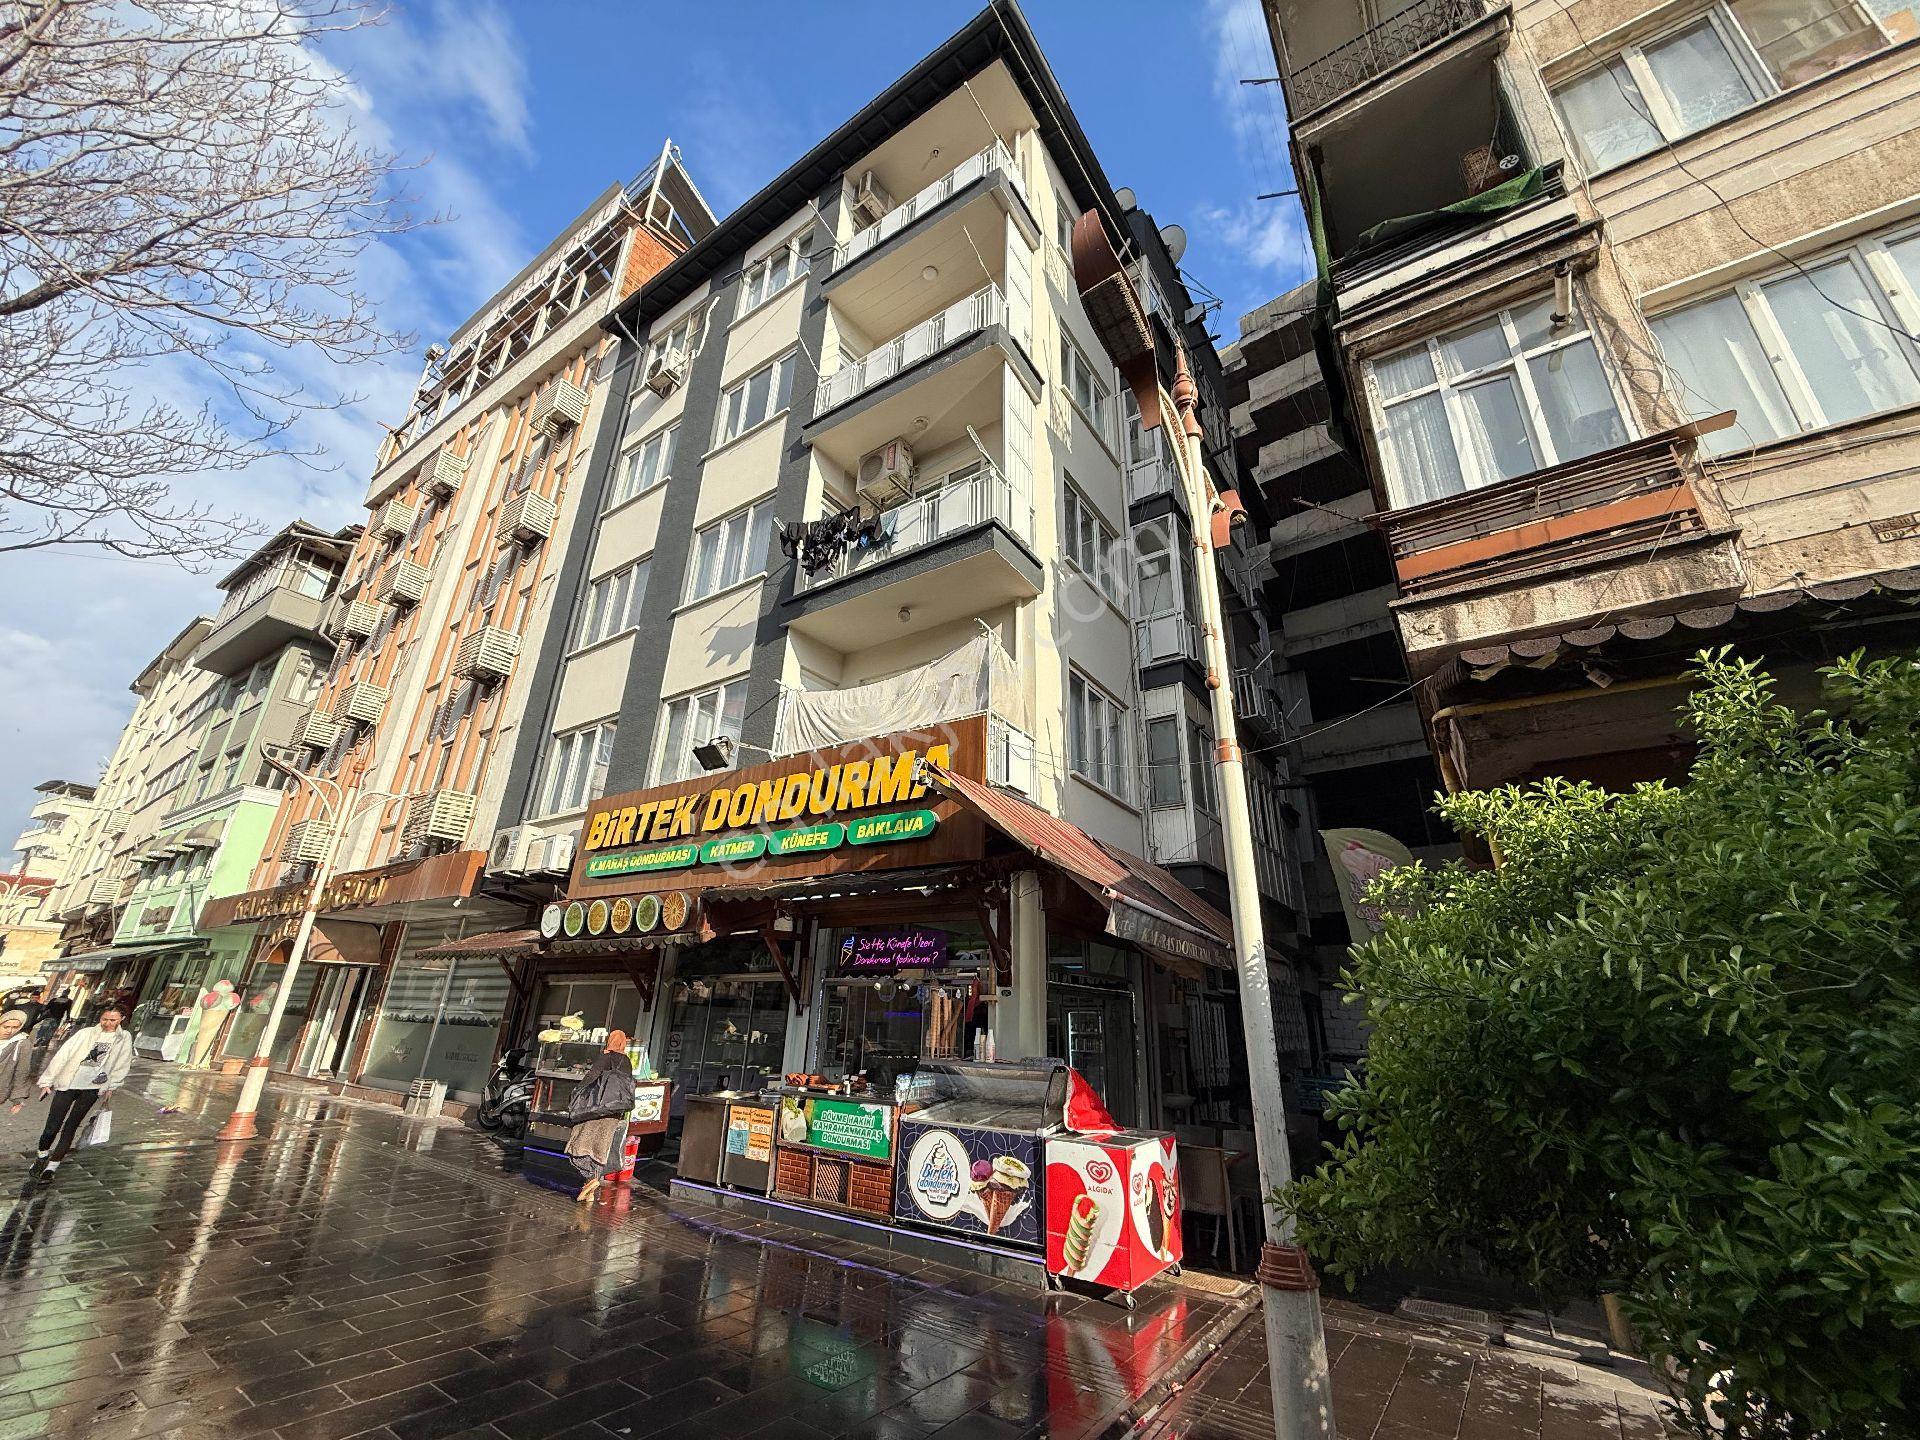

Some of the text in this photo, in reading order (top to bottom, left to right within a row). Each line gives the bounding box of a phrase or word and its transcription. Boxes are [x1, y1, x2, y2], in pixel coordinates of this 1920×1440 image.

[701, 743, 950, 832] DONDURMA
[856, 816, 923, 838] BAKLAVA
[710, 840, 755, 857] KATMER
[780, 831, 829, 850] KÜNEFE
[630, 848, 691, 867] DONDURMASI
[886, 936, 912, 951] Künefe
[913, 932, 936, 948] Üzeri
[853, 953, 892, 966] Dondurma
[821, 1104, 848, 1125] DÖVME
[812, 1119, 883, 1143] KAHRAMANMARAŞ
[919, 1179, 957, 1192] dondurma
